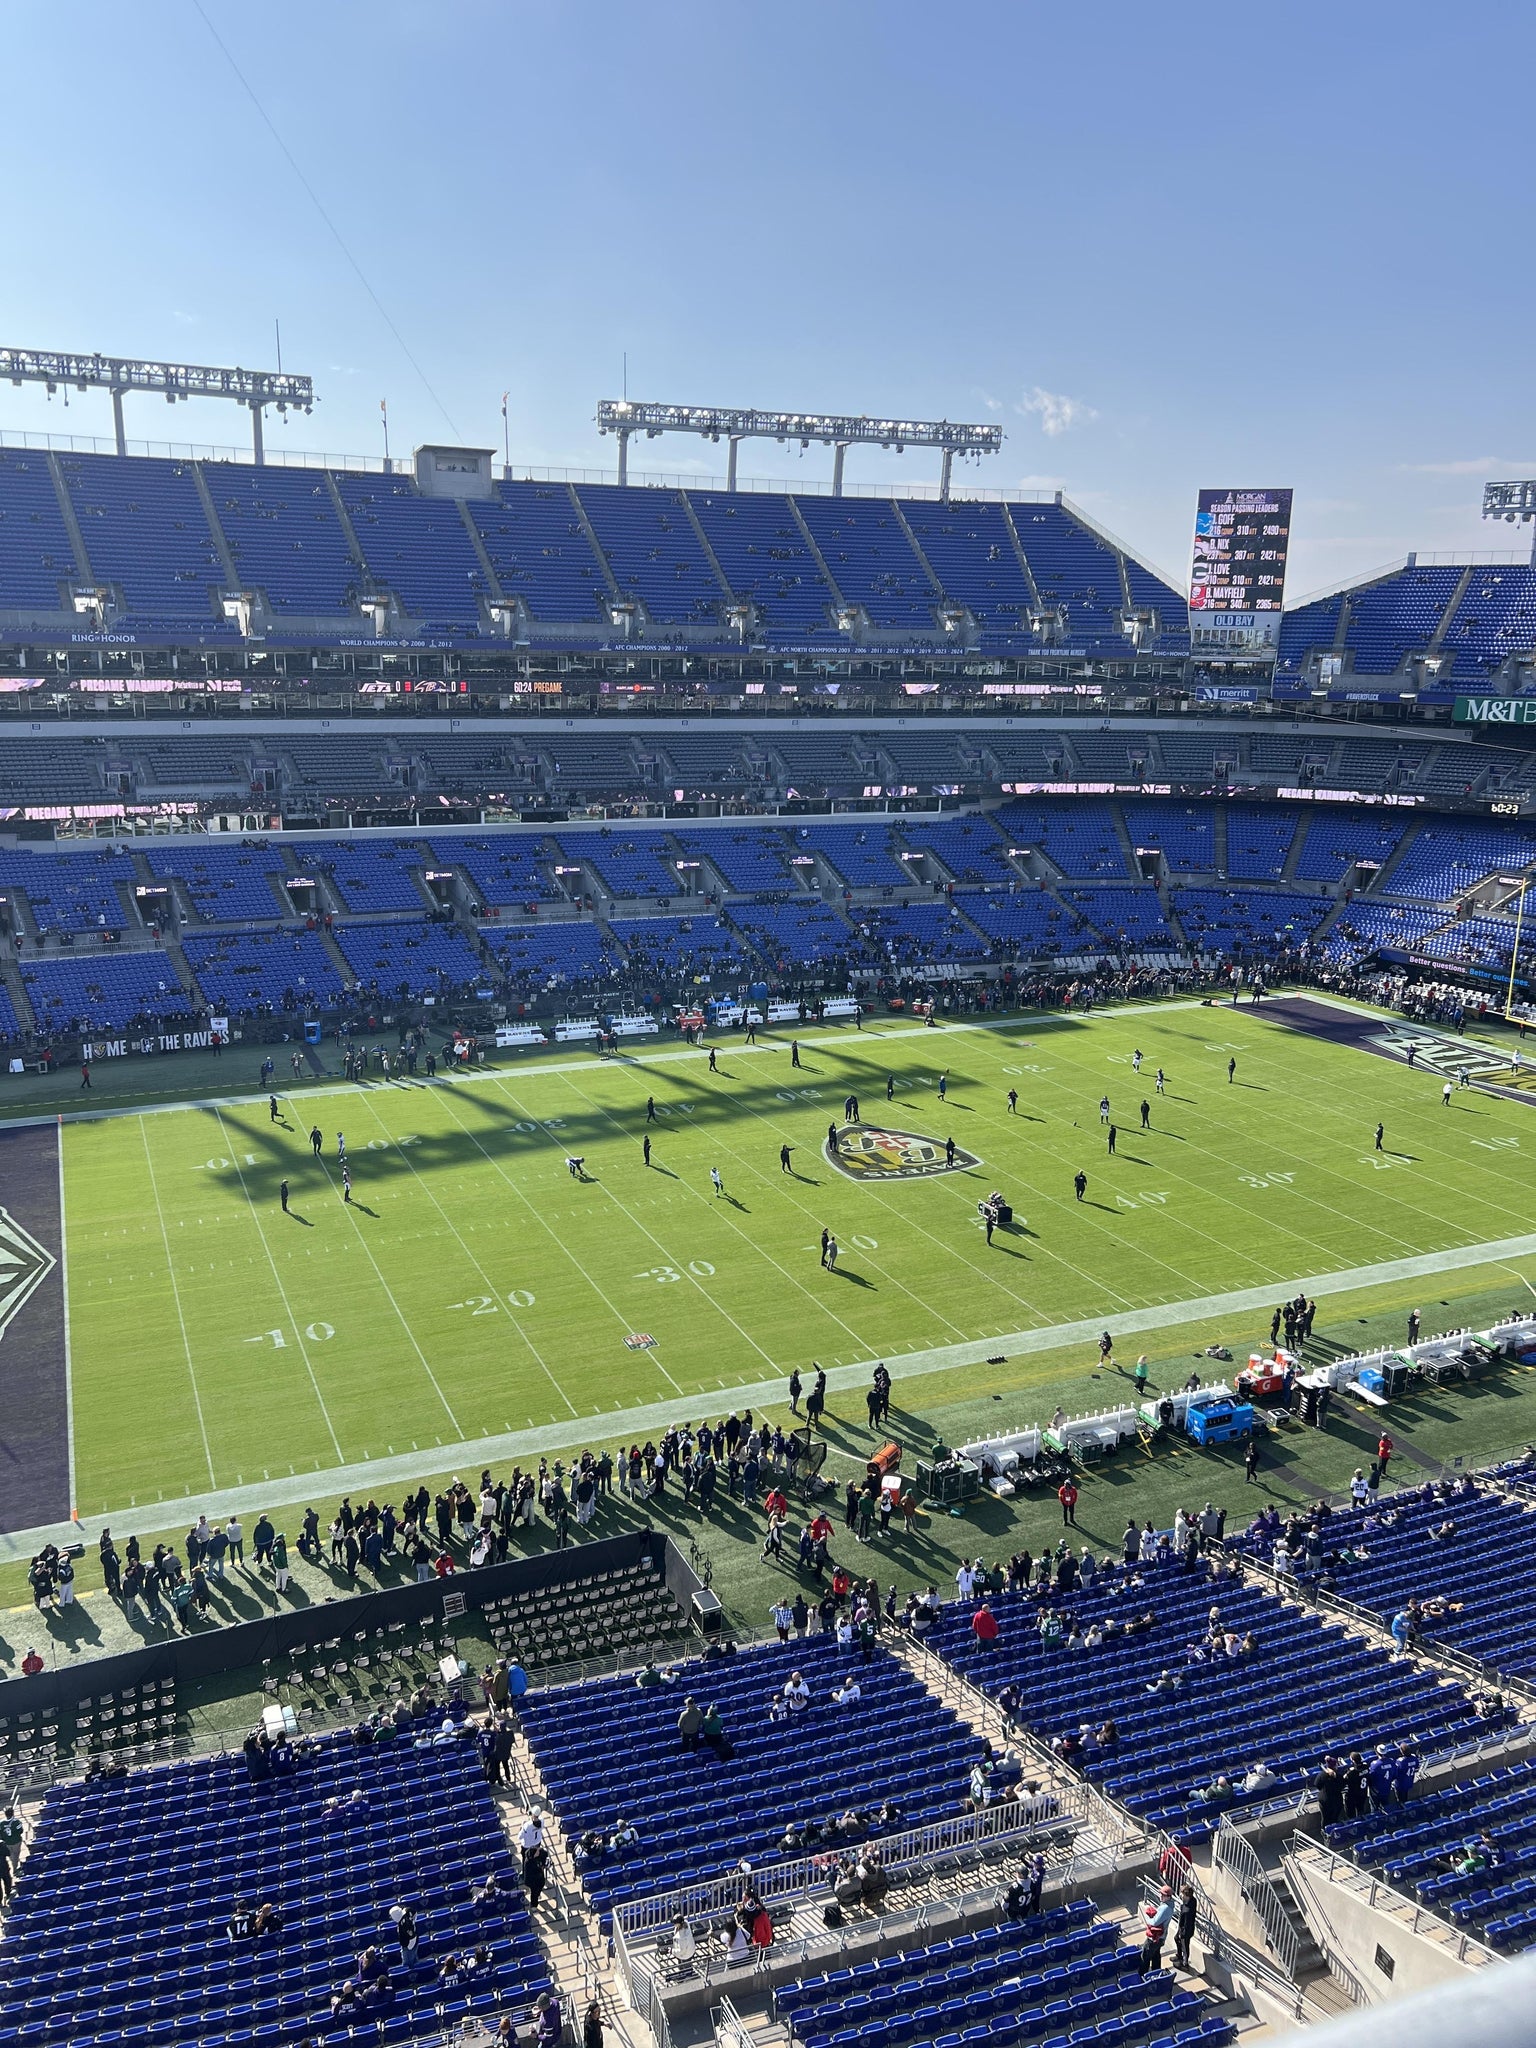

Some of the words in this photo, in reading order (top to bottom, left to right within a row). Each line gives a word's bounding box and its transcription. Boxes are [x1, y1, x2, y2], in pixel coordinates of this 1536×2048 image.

[1211, 504, 1231, 513] SEASON
[1232, 504, 1255, 513] PASSING
[1255, 504, 1279, 512] LEADERS
[1218, 514, 1235, 524] GOFF
[1237, 526, 1249, 535] 310
[1263, 525, 1279, 535] 2490
[1217, 539, 1230, 549] NIX
[1261, 550, 1276, 560] 2421
[1214, 564, 1230, 574] LOVE
[1206, 575, 1216, 585] 210
[1232, 575, 1244, 585] 310
[1258, 575, 1274, 585] 2421
[1206, 588, 1213, 598] B.
[1213, 588, 1245, 598] MAYFIELD
[1204, 599, 1214, 608] 216
[1230, 599, 1242, 608] 340
[1216, 616, 1233, 625] OLD
[1235, 616, 1253, 625] BAY
[72, 634, 95, 642] RING
[101, 635, 136, 643] HONOR
[80, 680, 125, 691] PREGAME
[126, 680, 174, 692] WARMUPS
[359, 681, 391, 692] JETS
[396, 681, 400, 692] 0
[451, 681, 456, 692] 0
[514, 682, 532, 693] 60:24
[534, 682, 562, 693] PREGAME
[983, 685, 1014, 694] PREGAME
[1220, 688, 1250, 697] merritt
[1465, 699, 1523, 722] M&T
[1044, 784, 1077, 793] PREGAME
[1078, 784, 1115, 793] WARMUPS
[1277, 788, 1313, 800] PREGAME
[1314, 790, 1356, 802] WARMUPS
[25, 806, 71, 820] PREGAME
[73, 804, 125, 819] WARMUPS
[1410, 956, 1430, 966] Better
[1432, 961, 1467, 974] questions.
[1469, 969, 1490, 978] Better
[738, 985, 749, 993] EST
[158, 1033, 180, 1050] THE
[776, 1089, 823, 1102] 50
[515, 1119, 568, 1132] 30
[367, 1136, 422, 1150] 20
[1470, 1137, 1518, 1151] 10
[207, 1154, 260, 1169] 10
[1357, 1153, 1412, 1170] 20
[1238, 1171, 1290, 1189] 30
[1116, 1191, 1166, 1210] 40
[650, 1260, 716, 1282] 30
[465, 1290, 536, 1316] 20
[265, 1322, 335, 1349] 10
[1262, 1380, 1271, 1391] G
[976, 1575, 985, 1583] 20
[867, 1625, 873, 1635] 5
[1048, 1626, 1059, 1636] 12
[484, 1738, 489, 1747] 8
[280, 1752, 284, 1761] 8
[1384, 1771, 1389, 1780] 4
[1360, 1778, 1367, 1789] 8
[236, 1921, 248, 1934] 14
